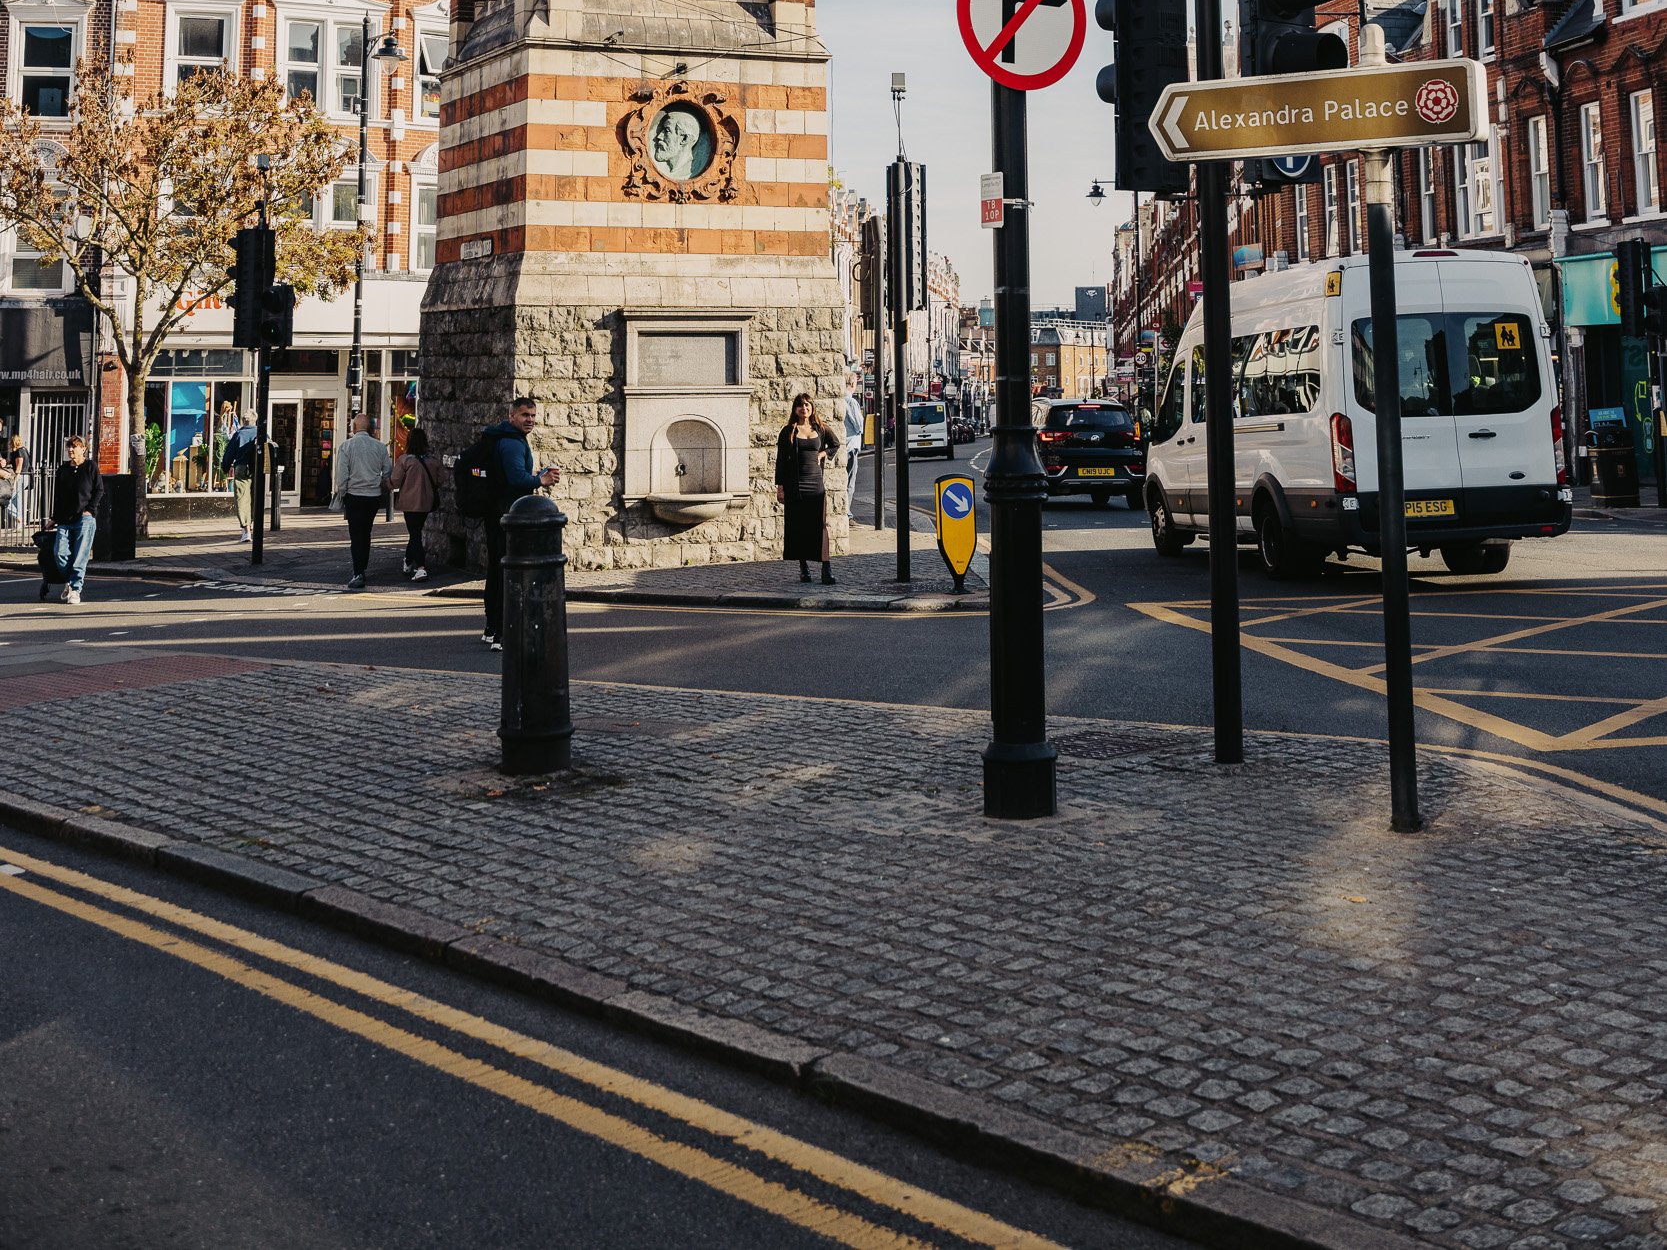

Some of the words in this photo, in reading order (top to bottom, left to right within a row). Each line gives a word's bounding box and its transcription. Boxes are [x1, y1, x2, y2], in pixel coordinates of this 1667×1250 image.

[1194, 104, 1314, 131] Alexandra
[1324, 98, 1409, 121] Palace
[0, 369, 81, 380] w.mp4hair.co.uk
[1404, 502, 1423, 513] P15
[1425, 501, 1447, 512] ESG
